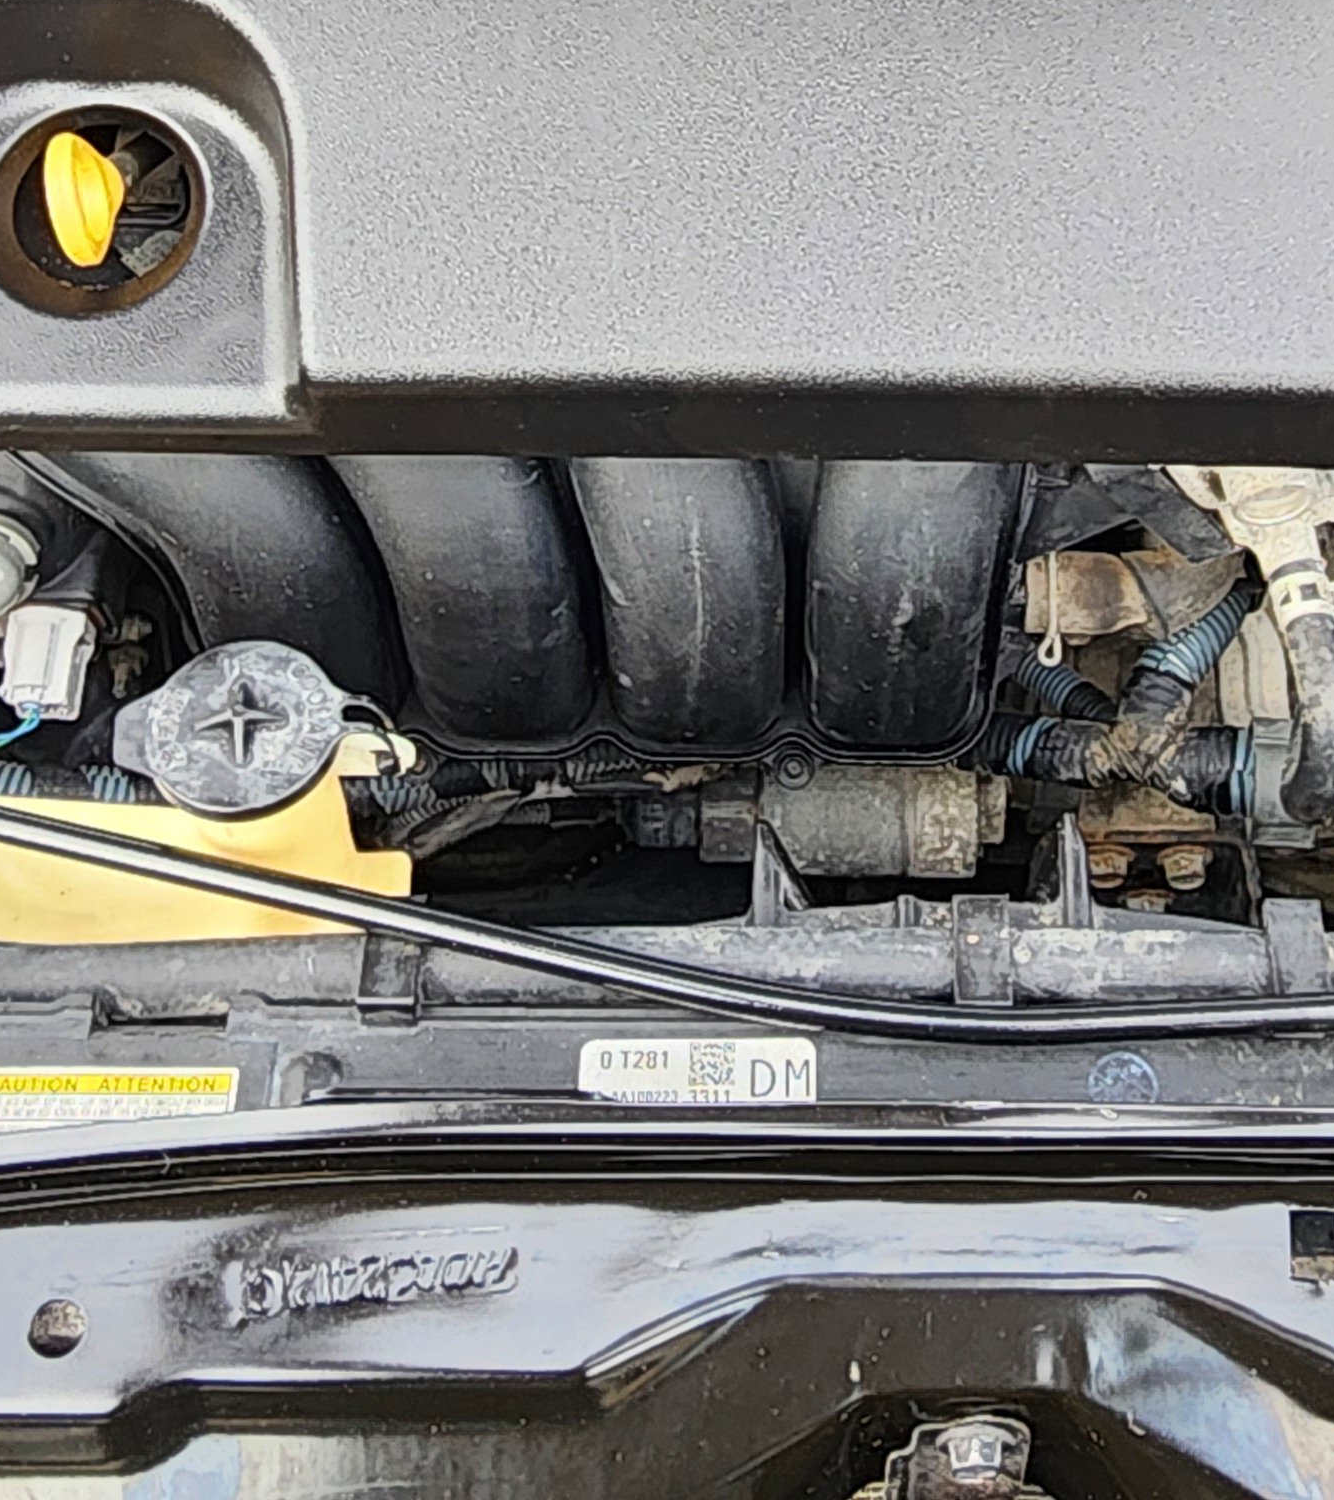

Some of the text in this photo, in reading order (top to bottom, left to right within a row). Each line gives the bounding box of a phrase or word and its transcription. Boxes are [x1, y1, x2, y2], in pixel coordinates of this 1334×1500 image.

[621, 1050, 669, 1070] T281
[97, 1076, 219, 1093] ATTENTION
[750, 1058, 811, 1098] DM
